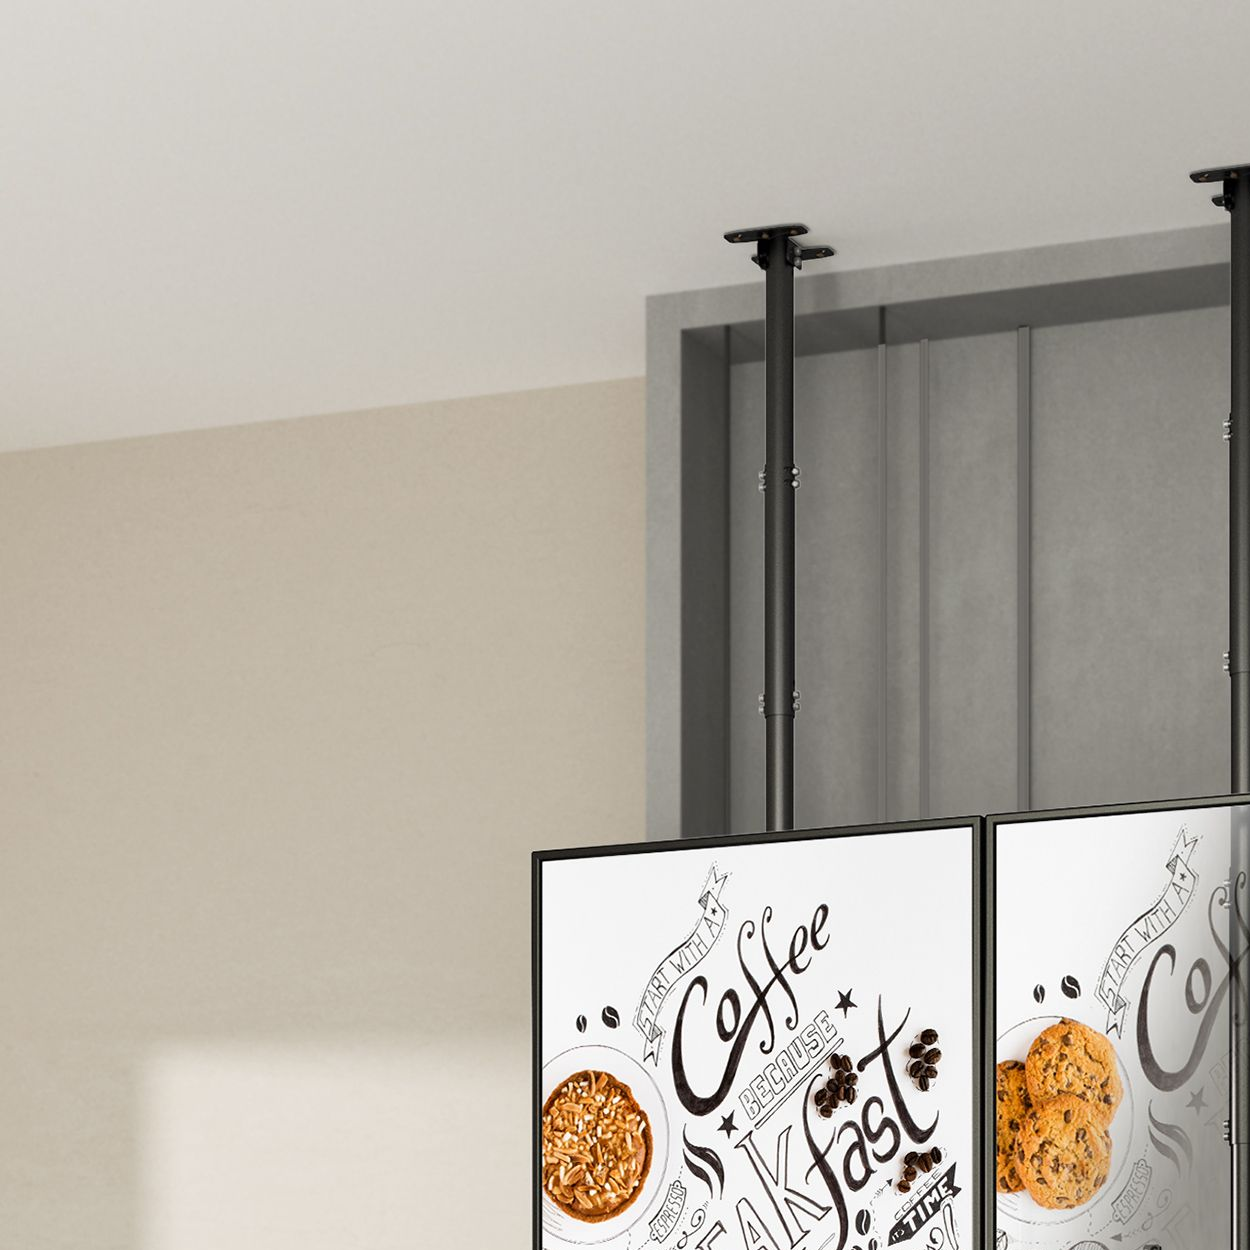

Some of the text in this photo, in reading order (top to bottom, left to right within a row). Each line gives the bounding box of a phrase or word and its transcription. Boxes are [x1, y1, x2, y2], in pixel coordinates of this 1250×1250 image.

[639, 916, 721, 1037] START WITH A
[1101, 882, 1190, 1007] START WITH A
[671, 903, 831, 1117] Coffee
[738, 1009, 838, 1121] BECAUSE
[653, 1186, 684, 1238] ESPRESSO
[894, 1169, 943, 1221] COFFEE
[902, 1175, 953, 1232] TIME
[1116, 1166, 1150, 1220] ESPRESSO
